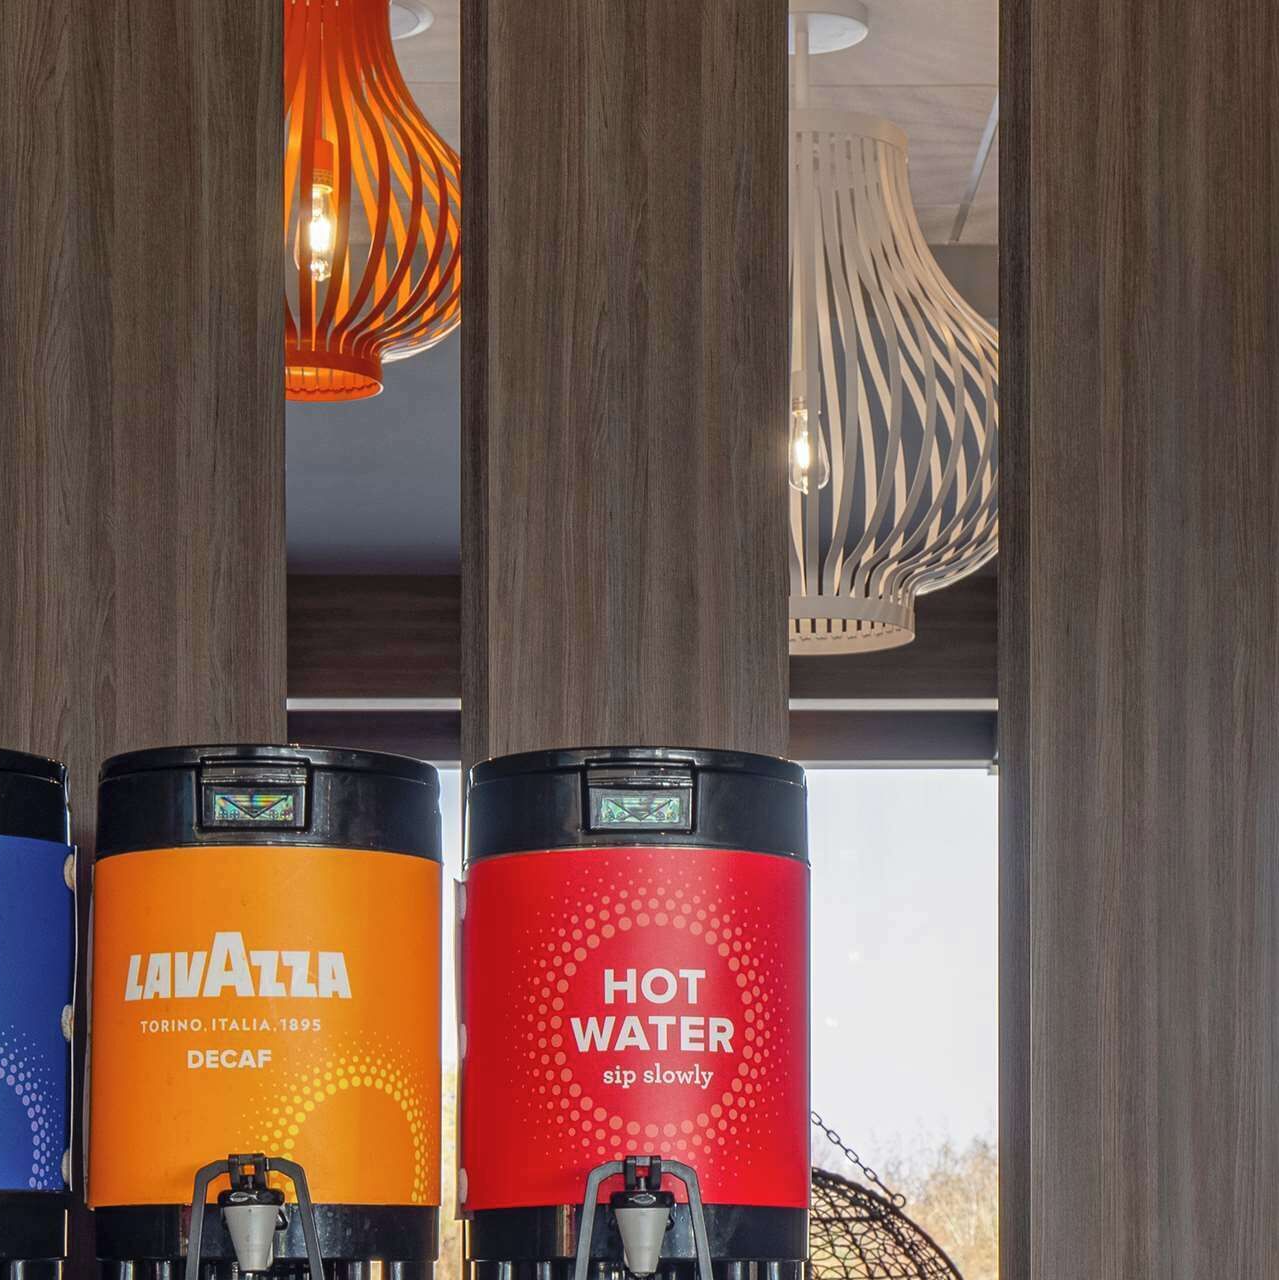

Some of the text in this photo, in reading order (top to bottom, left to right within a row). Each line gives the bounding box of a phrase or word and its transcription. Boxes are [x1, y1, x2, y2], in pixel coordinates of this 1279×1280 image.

[124, 931, 352, 1001] LAVAZZA
[604, 968, 706, 1004] HOT
[280, 1018, 321, 1032] 1895
[570, 1015, 735, 1053] WATER
[187, 1049, 272, 1069] DECAF
[603, 1062, 714, 1089] sip slowly
